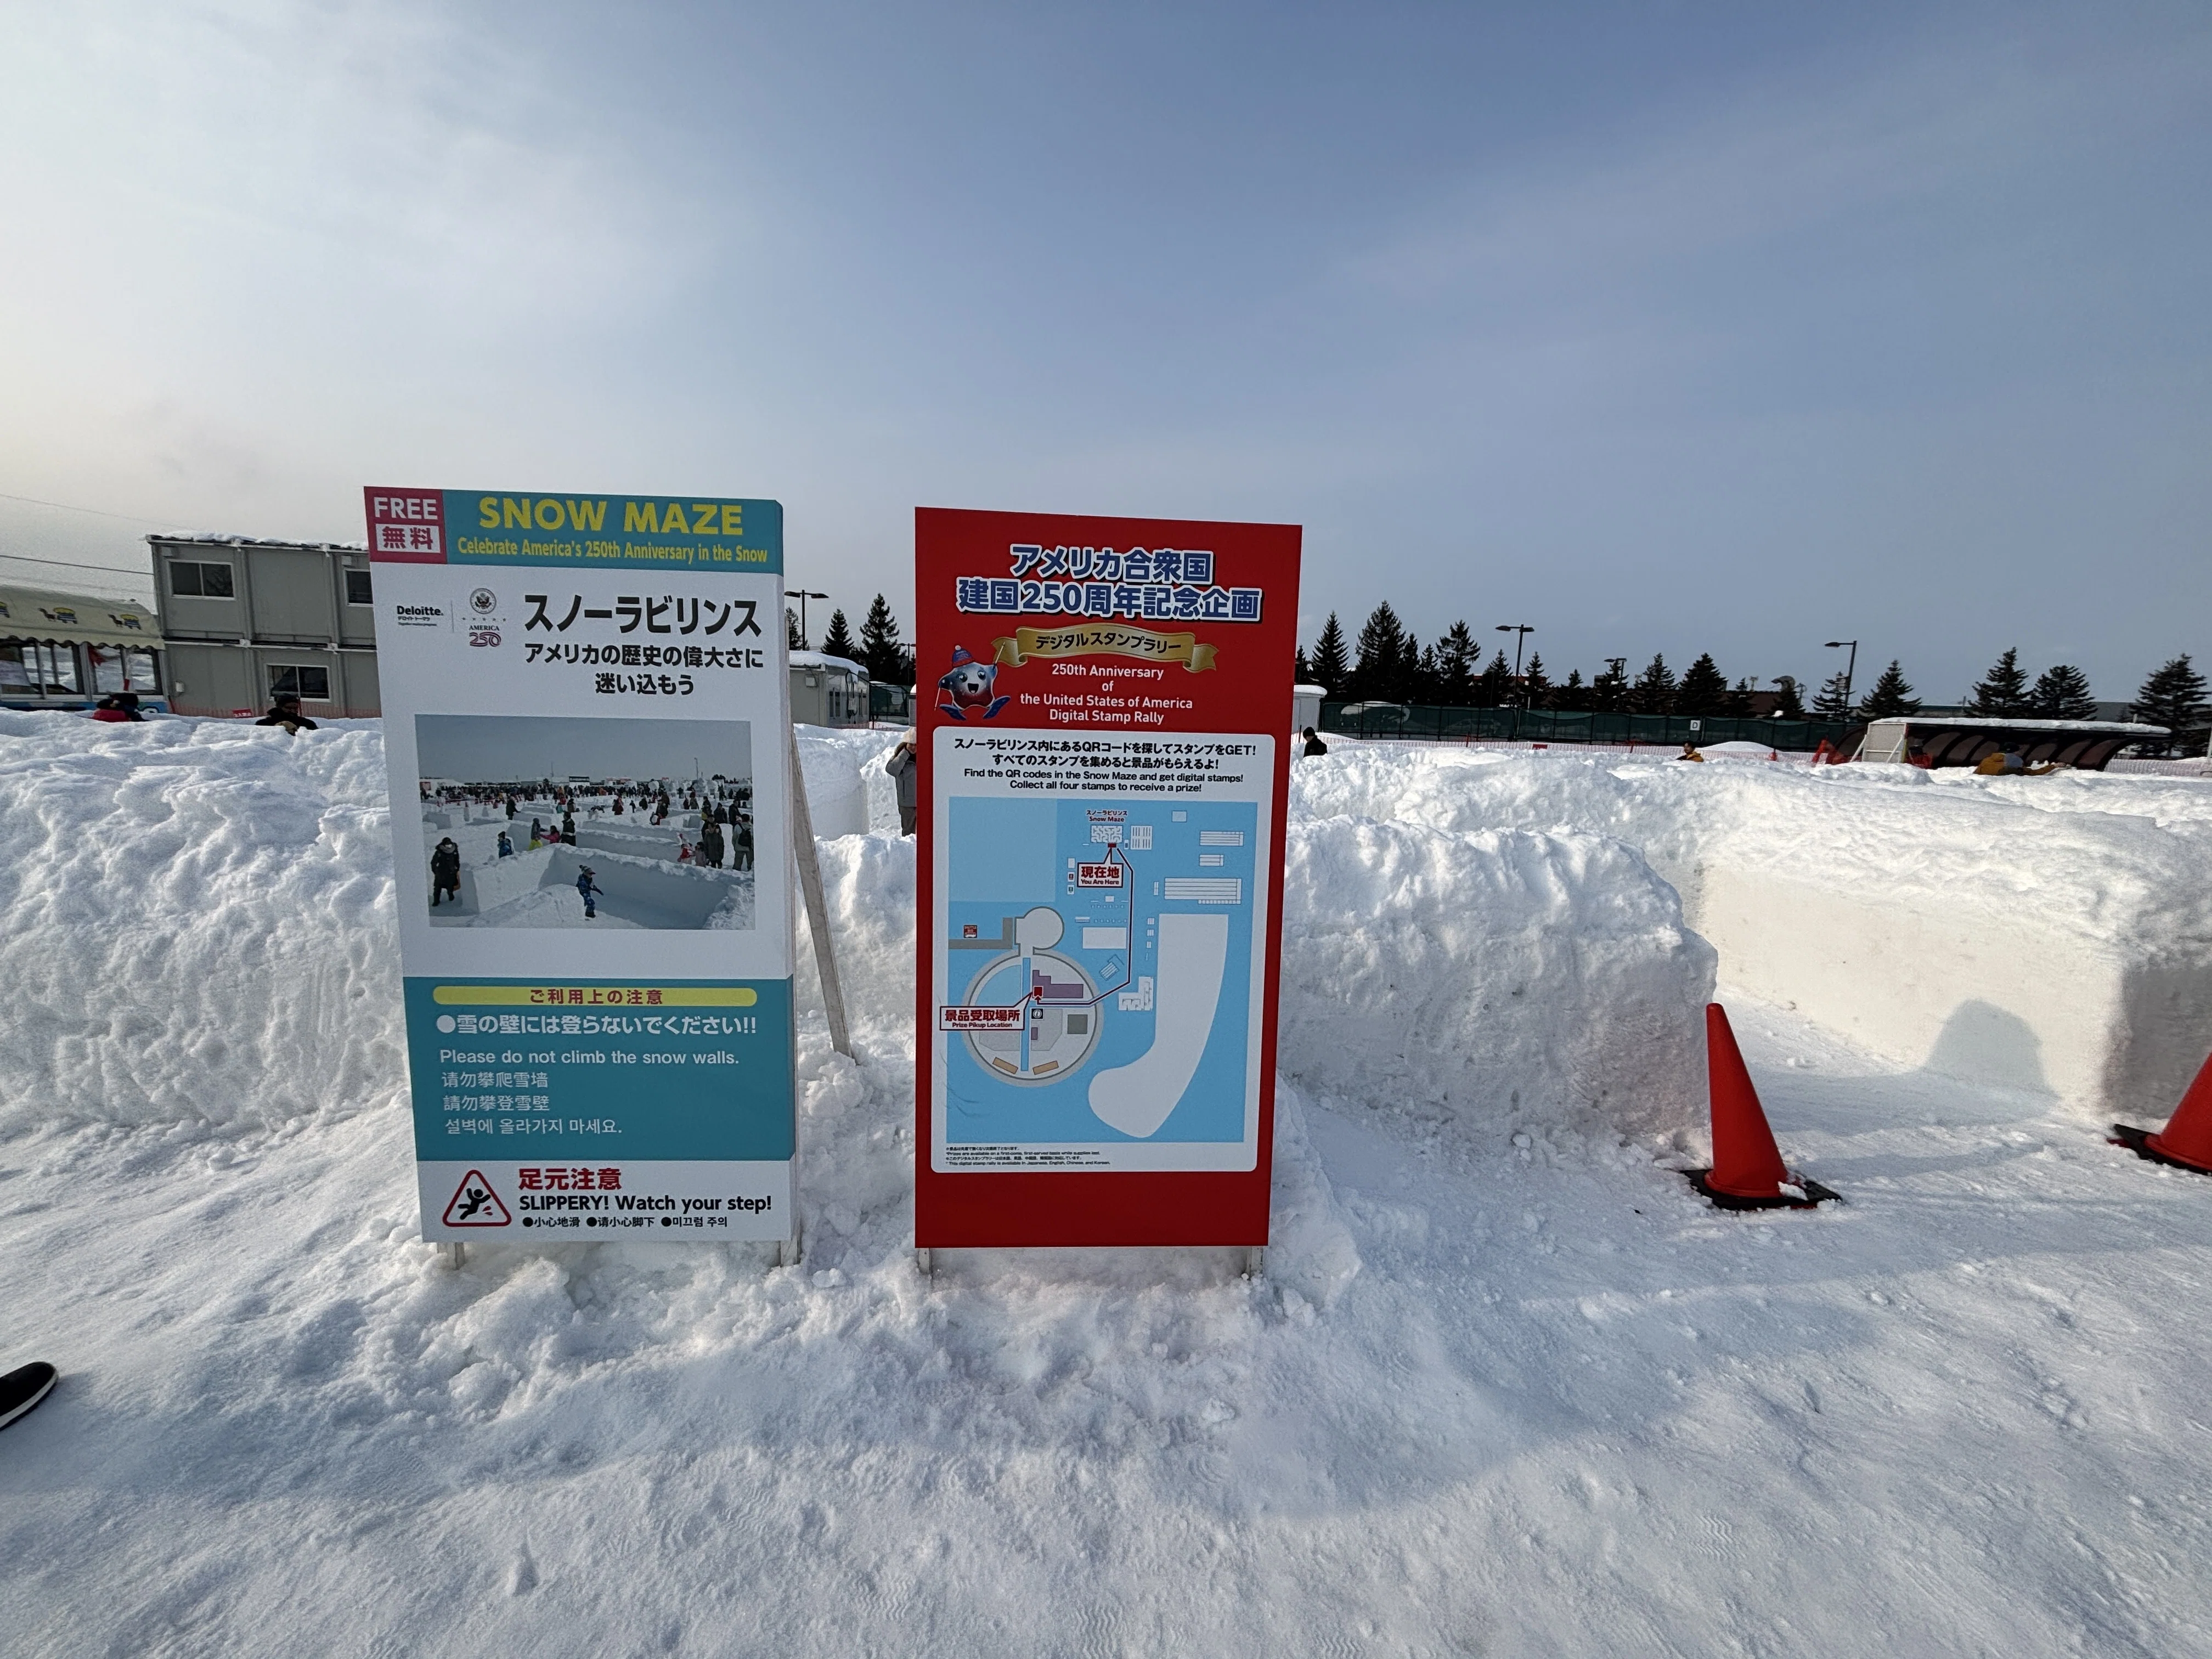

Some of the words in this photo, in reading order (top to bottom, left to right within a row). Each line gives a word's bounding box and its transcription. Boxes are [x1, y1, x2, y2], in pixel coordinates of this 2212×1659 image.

[374, 497, 438, 520] FREE
[479, 495, 606, 530] SNOW
[623, 501, 743, 535] MAZE
[382, 526, 433, 550] 無料
[458, 537, 518, 556] Celebrate
[522, 539, 582, 557] America's
[585, 540, 620, 558] 250th
[624, 542, 694, 564] Anniversary
[698, 544, 709, 561] in
[713, 545, 732, 562] the
[736, 546, 768, 563] Snow
[1010, 544, 1212, 584] アメリカ合衆国
[957, 577, 1262, 622] 建国250周年記念企画
[397, 605, 444, 616] Deloitte.
[524, 594, 762, 637] スノーラビリンス
[469, 632, 501, 647] 250
[1036, 632, 1181, 653] デジタルスタンプラリー
[524, 644, 764, 669] アメリカの歴史の偉大さに
[1052, 663, 1086, 676] 250th
[1090, 664, 1164, 680] Anniversary
[595, 673, 695, 695] 迷い込もう
[1102, 680, 1114, 692] of
[1020, 693, 1040, 706] the
[1043, 694, 1084, 707] United
[1086, 695, 1125, 708] States
[1128, 696, 1140, 708] of
[1142, 697, 1193, 709] America
[1049, 710, 1089, 724] Digital
[1092, 711, 1132, 726] Stamp
[1135, 712, 1164, 726] Rally
[964, 769, 985, 777] Find
[988, 769, 1003, 777] the
[1006, 770, 1020, 778] QR
[1054, 770, 1063, 778] in
[1065, 771, 1081, 779] the
[1112, 772, 1137, 780] Maze
[1159, 774, 1175, 782] get
[1177, 774, 1205, 782] digital
[1207, 774, 1243, 783] stamps!
[1010, 780, 1043, 789] Collect
[1081, 782, 1115, 791] stamps
[1176, 784, 1201, 792] prize!
[1081, 866, 1120, 878] 現在地
[530, 989, 662, 1005] ご利用上の注意
[945, 1009, 1020, 1022] 景品受取場所
[440, 1049, 495, 1064] Please
[501, 1049, 522, 1064] do
[529, 1050, 556, 1064] not
[561, 1050, 605, 1064] climb
[612, 1050, 636, 1064] the
[643, 1053, 686, 1064] snow
[692, 1051, 739, 1064] walls.
[442, 1071, 549, 1088] 请勿攀爬雪墙
[443, 1095, 550, 1111] 請勿攀登雪壁
[445, 1119, 493, 1135] 설벽에
[499, 1119, 563, 1135] 올라가지
[569, 1119, 622, 1135] 마세요.
[518, 1168, 622, 1190] 足元注意
[520, 1195, 609, 1211] SLIPPERY!
[615, 1195, 676, 1211] Watch
[682, 1198, 722, 1215] your
[727, 1195, 772, 1215] step!
[533, 1217, 580, 1228] 小心地滑
[598, 1217, 655, 1228] 请小心脚下
[673, 1216, 704, 1228] 미끄럼
[707, 1216, 728, 1228] 주의
